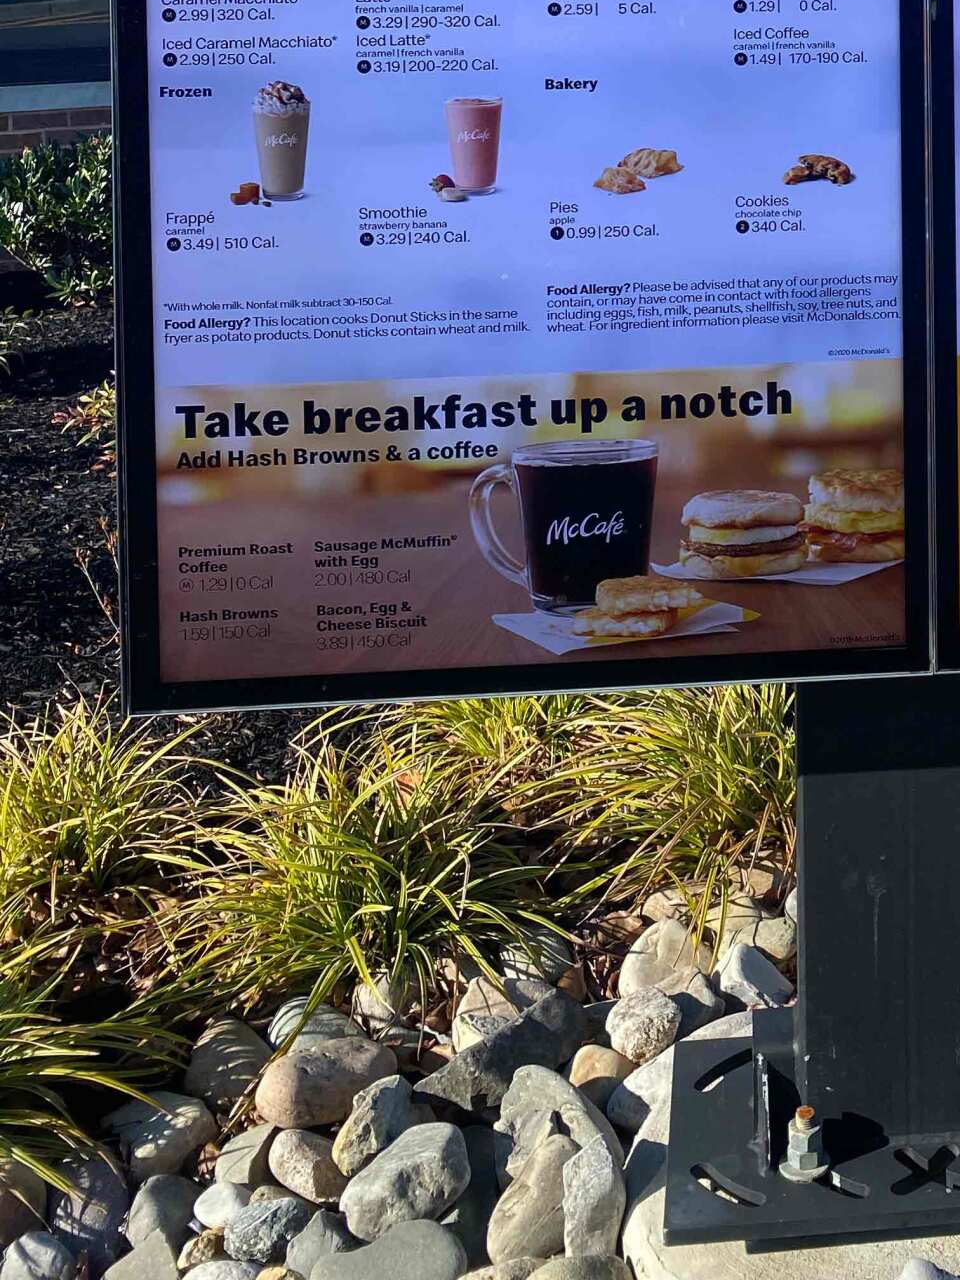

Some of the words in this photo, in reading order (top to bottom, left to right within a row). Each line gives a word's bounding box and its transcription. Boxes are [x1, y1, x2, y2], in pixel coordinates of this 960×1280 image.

[159, 86, 212, 98] Frozen
[544, 77, 598, 93] Bakery
[550, 201, 579, 214] Pies
[735, 194, 789, 208] Cookies
[166, 210, 215, 227] Frappé
[358, 205, 427, 220] Smoothie
[734, 209, 781, 219] chocolate
[781, 207, 802, 218] chip
[164, 226, 205, 236] caramel
[359, 220, 411, 232] strawberry
[411, 220, 448, 229] banana
[751, 220, 777, 233] 340
[780, 219, 805, 232] Cal.
[546, 284, 578, 296] Food
[632, 281, 671, 293] Please
[673, 280, 688, 291] be
[690, 278, 735, 291] advised
[737, 277, 760, 289] that
[762, 279, 784, 291] any
[785, 275, 797, 290] of
[799, 278, 819, 290] our
[820, 274, 872, 289] products
[873, 275, 898, 286] may
[175, 402, 289, 439] Take
[303, 393, 537, 434] breakfast
[550, 397, 607, 425] up
[621, 395, 646, 422] a
[660, 381, 792, 420] notch
[175, 450, 221, 470] Add
[227, 448, 287, 468] Hash
[293, 448, 380, 465] Browns
[385, 444, 402, 462] &
[407, 447, 421, 461] a
[426, 440, 498, 460] coffee
[546, 510, 625, 546] McCafé
[179, 609, 218, 622] Hash
[221, 608, 279, 621] Browns
